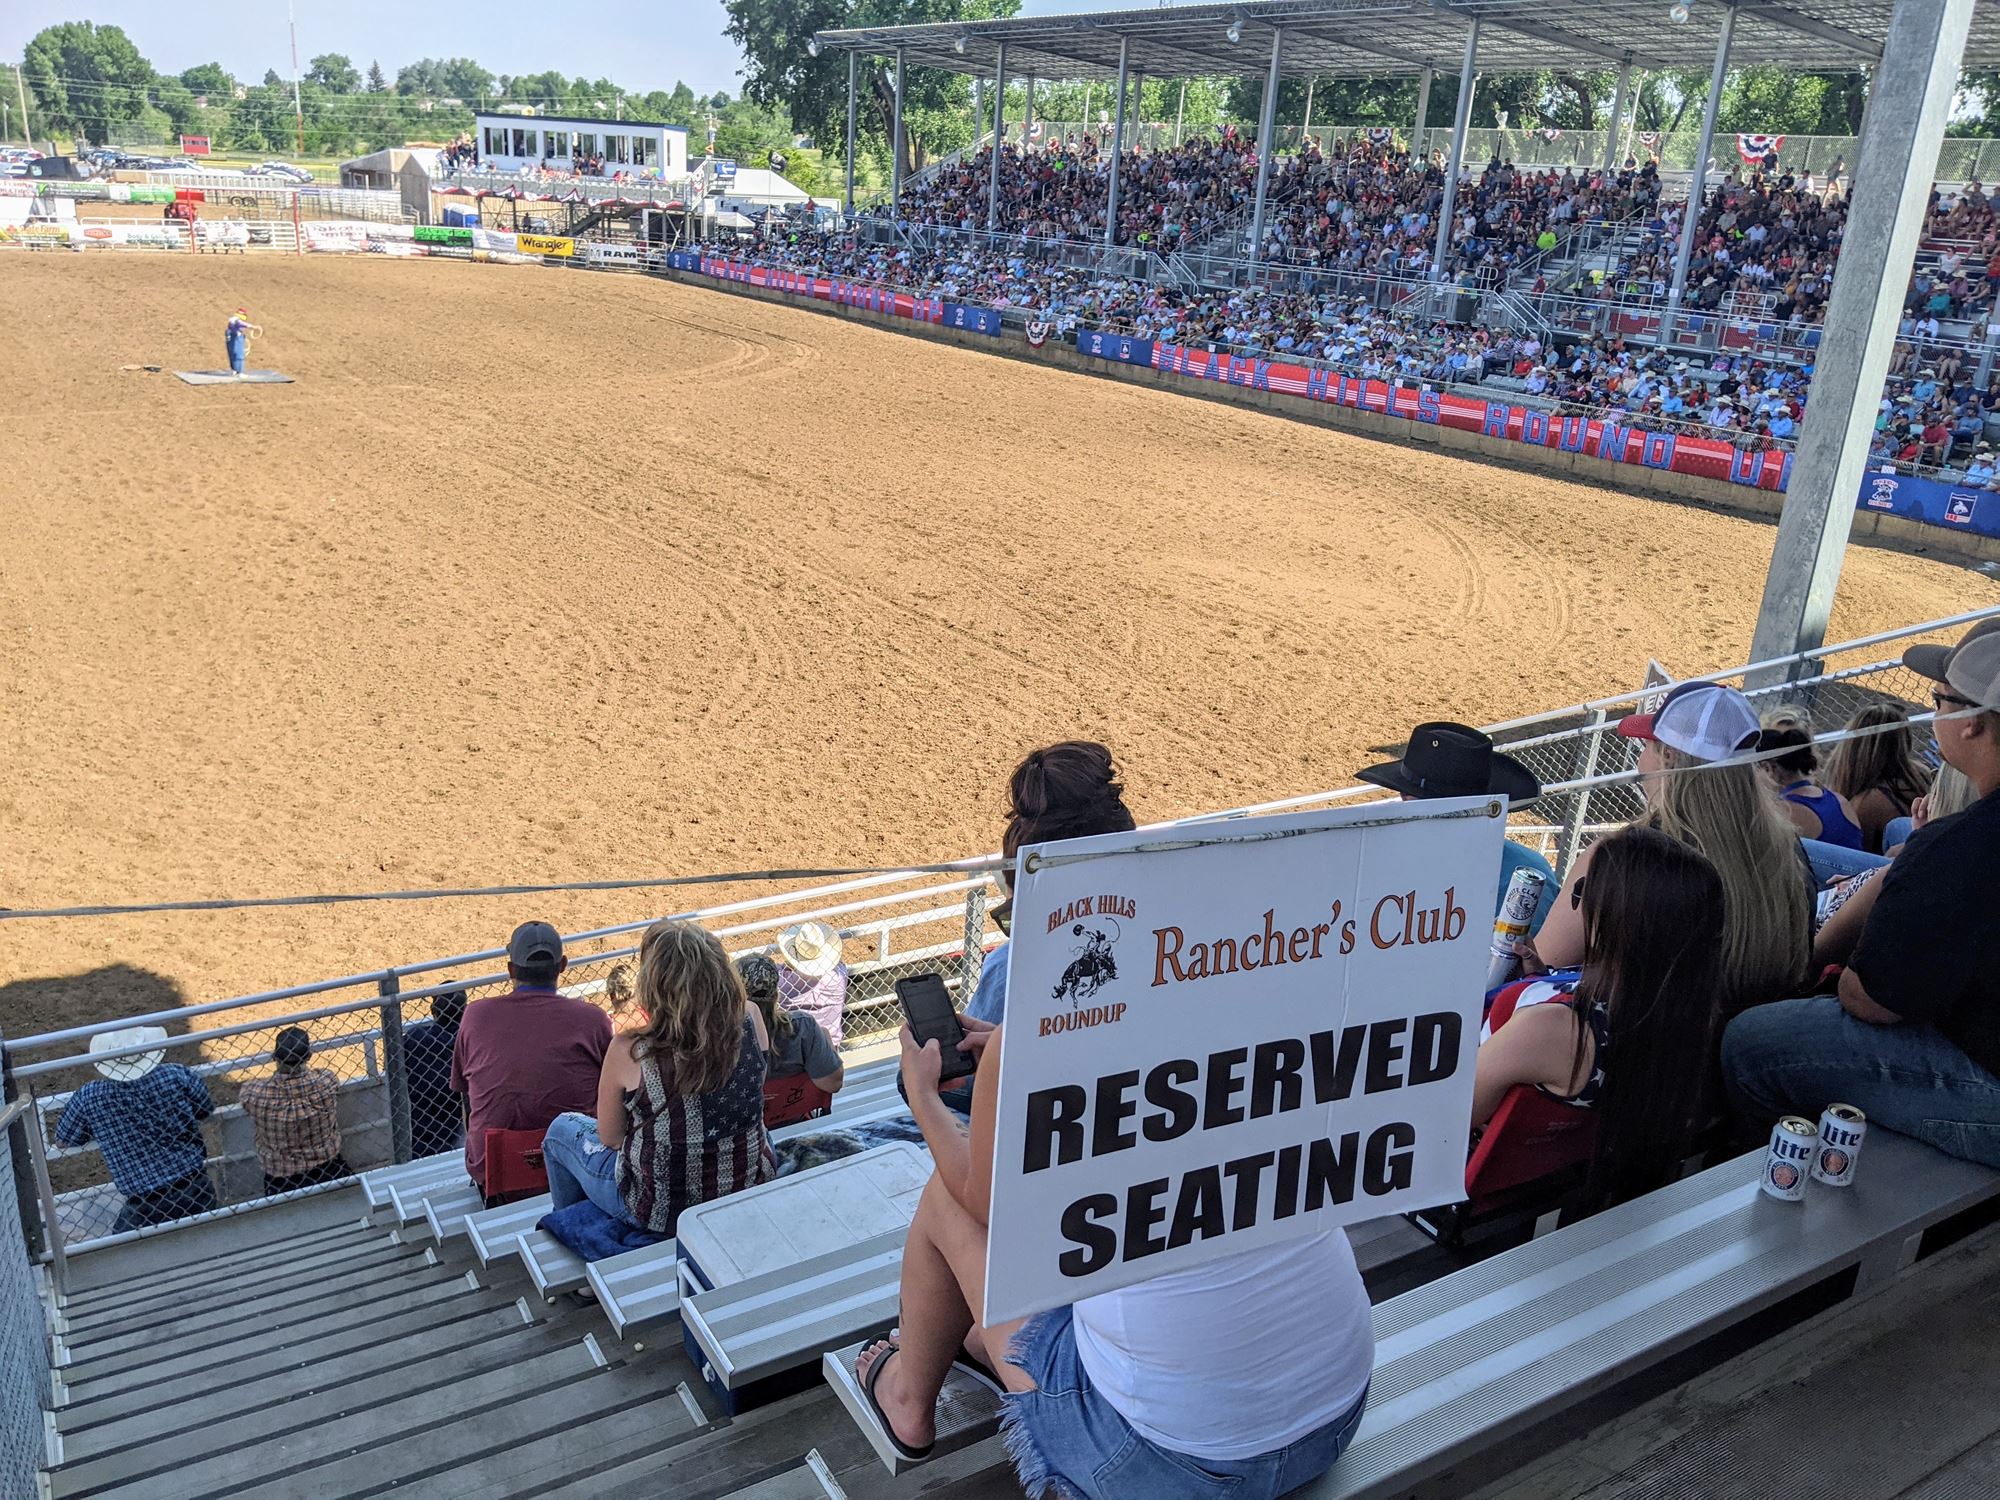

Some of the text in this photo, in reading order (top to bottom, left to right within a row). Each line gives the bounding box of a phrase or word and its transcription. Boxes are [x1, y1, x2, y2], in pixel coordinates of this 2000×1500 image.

[521, 235, 567, 252] Wrangler
[603, 251, 637, 259] RAM
[1158, 342, 1272, 392] BLACK
[1306, 369, 1441, 424] HILLS
[1483, 402, 1676, 470] ROUND
[1046, 894, 1136, 934] BLACK HILLS
[1151, 886, 1466, 987] Rancher's Club
[1038, 1002, 1127, 1037] ROUNDUP
[1022, 1011, 1463, 1175] RESERVED
[1772, 1133, 1811, 1161] Lite
[1822, 1121, 1861, 1146] Lite
[1058, 1122, 1416, 1278] SEATING
